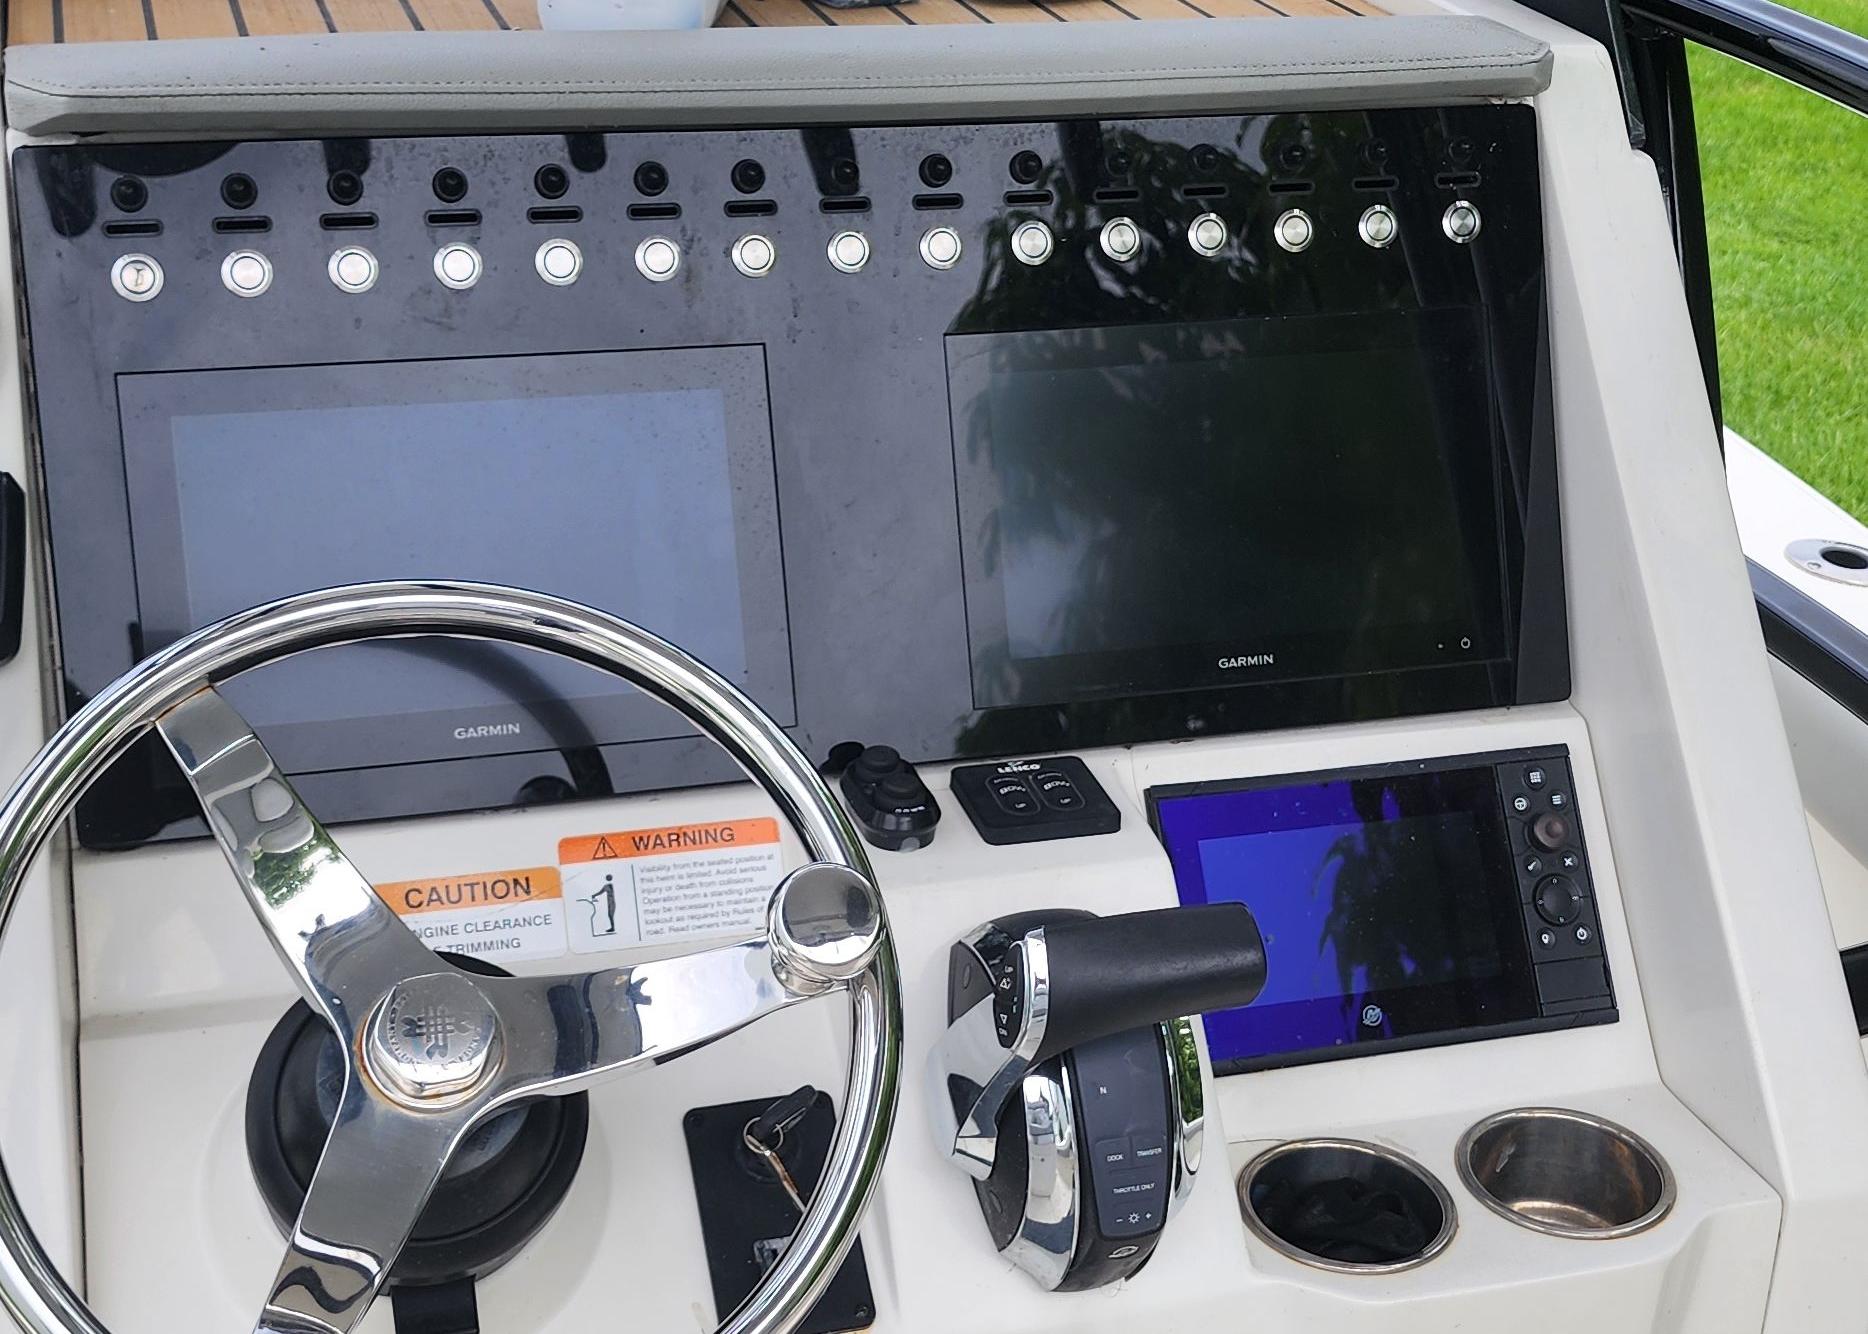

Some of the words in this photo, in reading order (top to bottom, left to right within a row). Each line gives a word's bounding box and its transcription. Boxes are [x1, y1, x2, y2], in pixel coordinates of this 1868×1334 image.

[1218, 654, 1274, 669] GARMIN
[453, 722, 521, 740] GARMIN
[997, 763, 1041, 774] LENCO
[631, 827, 736, 852] WARNING
[707, 858, 733, 866] seated
[735, 855, 765, 864] position
[739, 865, 767, 873] serious
[404, 875, 532, 909] CAUTION
[641, 886, 663, 895] injury
[643, 895, 681, 905] Operation
[710, 888, 743, 897] standing
[745, 884, 775, 895] position
[675, 902, 714, 911] necessary
[726, 896, 760, 905] maintain
[687, 911, 719, 921] required
[721, 910, 730, 918] by
[412, 923, 460, 939] NGINE
[463, 913, 553, 934] CLEARANCE
[668, 924, 690, 932] Read
[446, 937, 522, 955] TRIMMING
[1099, 1086, 1107, 1095] N
[1106, 1153, 1124, 1162] DOCK
[1136, 1147, 1163, 1158] TRANSFER
[1112, 1185, 1140, 1194] THROTTLE
[1141, 1182, 1156, 1191] ONLY
